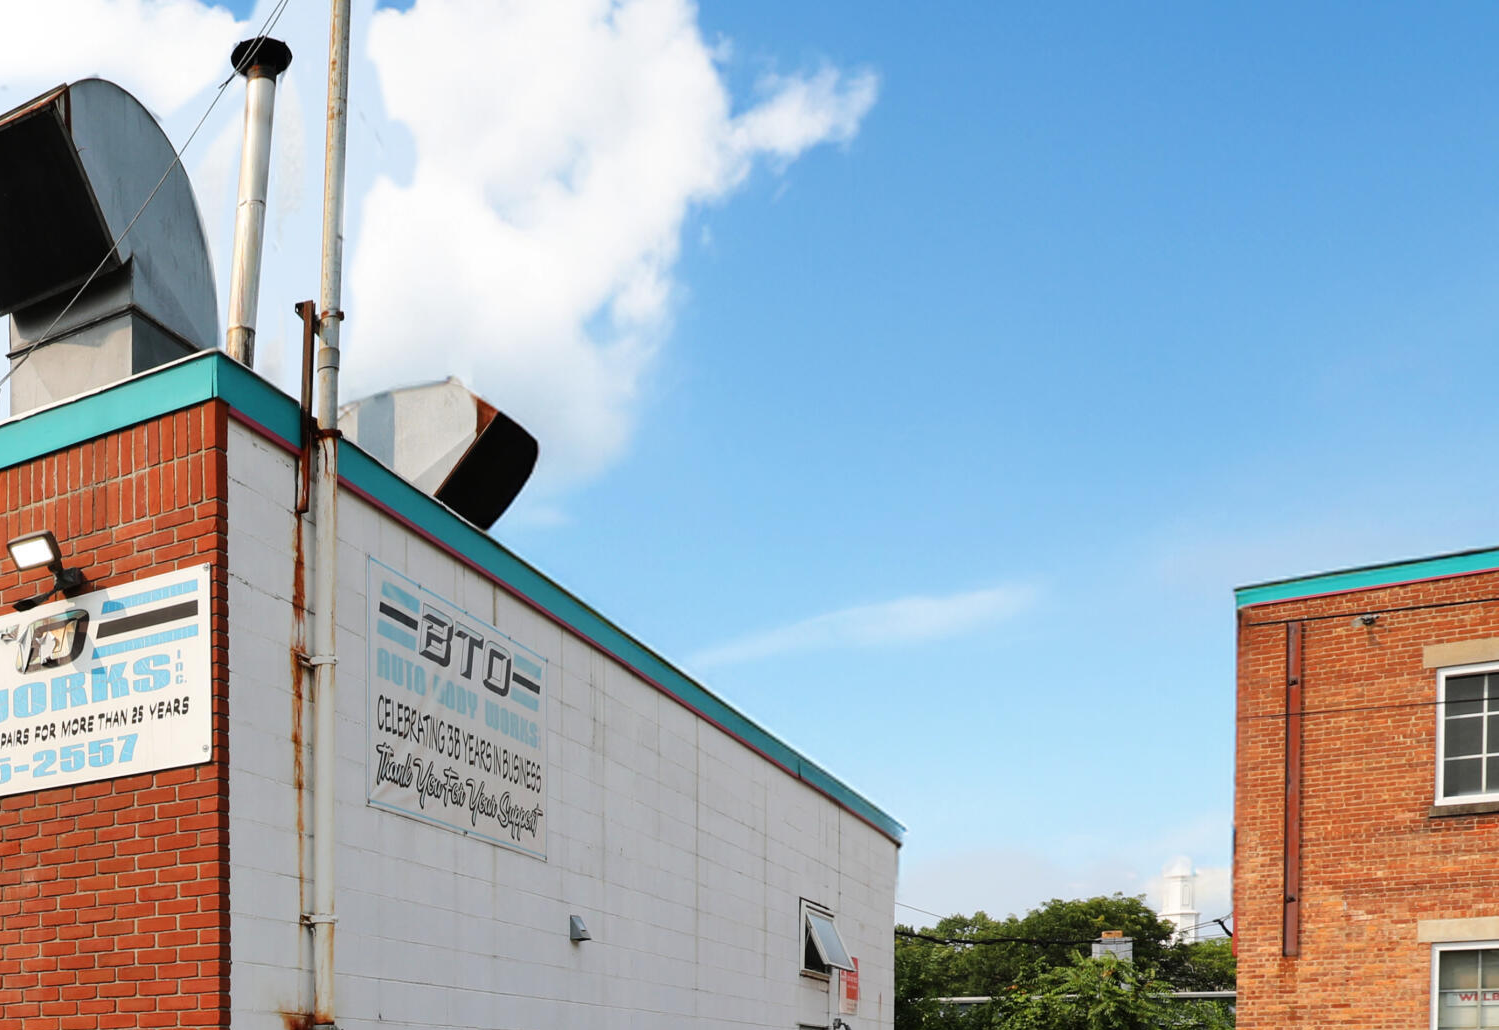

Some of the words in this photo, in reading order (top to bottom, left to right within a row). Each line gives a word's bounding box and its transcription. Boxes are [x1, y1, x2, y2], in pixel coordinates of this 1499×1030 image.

[376, 647, 427, 697] AUTO
[484, 698, 538, 749] WORKS
[419, 602, 512, 697] BTO
[34, 722, 56, 742] FOR
[61, 715, 95, 738] MORE
[98, 708, 128, 731] THAN
[131, 705, 144, 724] 25
[149, 696, 190, 720] YEARS
[377, 694, 445, 754] CELEBRATING
[447, 723, 461, 760] 38
[462, 730, 493, 773] YEARS
[493, 743, 502, 776] IN
[502, 749, 542, 794] BUSINESS
[376, 741, 414, 788] Thank
[412, 757, 444, 810] You
[443, 766, 466, 808] For
[465, 778, 498, 827] Your
[497, 791, 544, 841] Support
